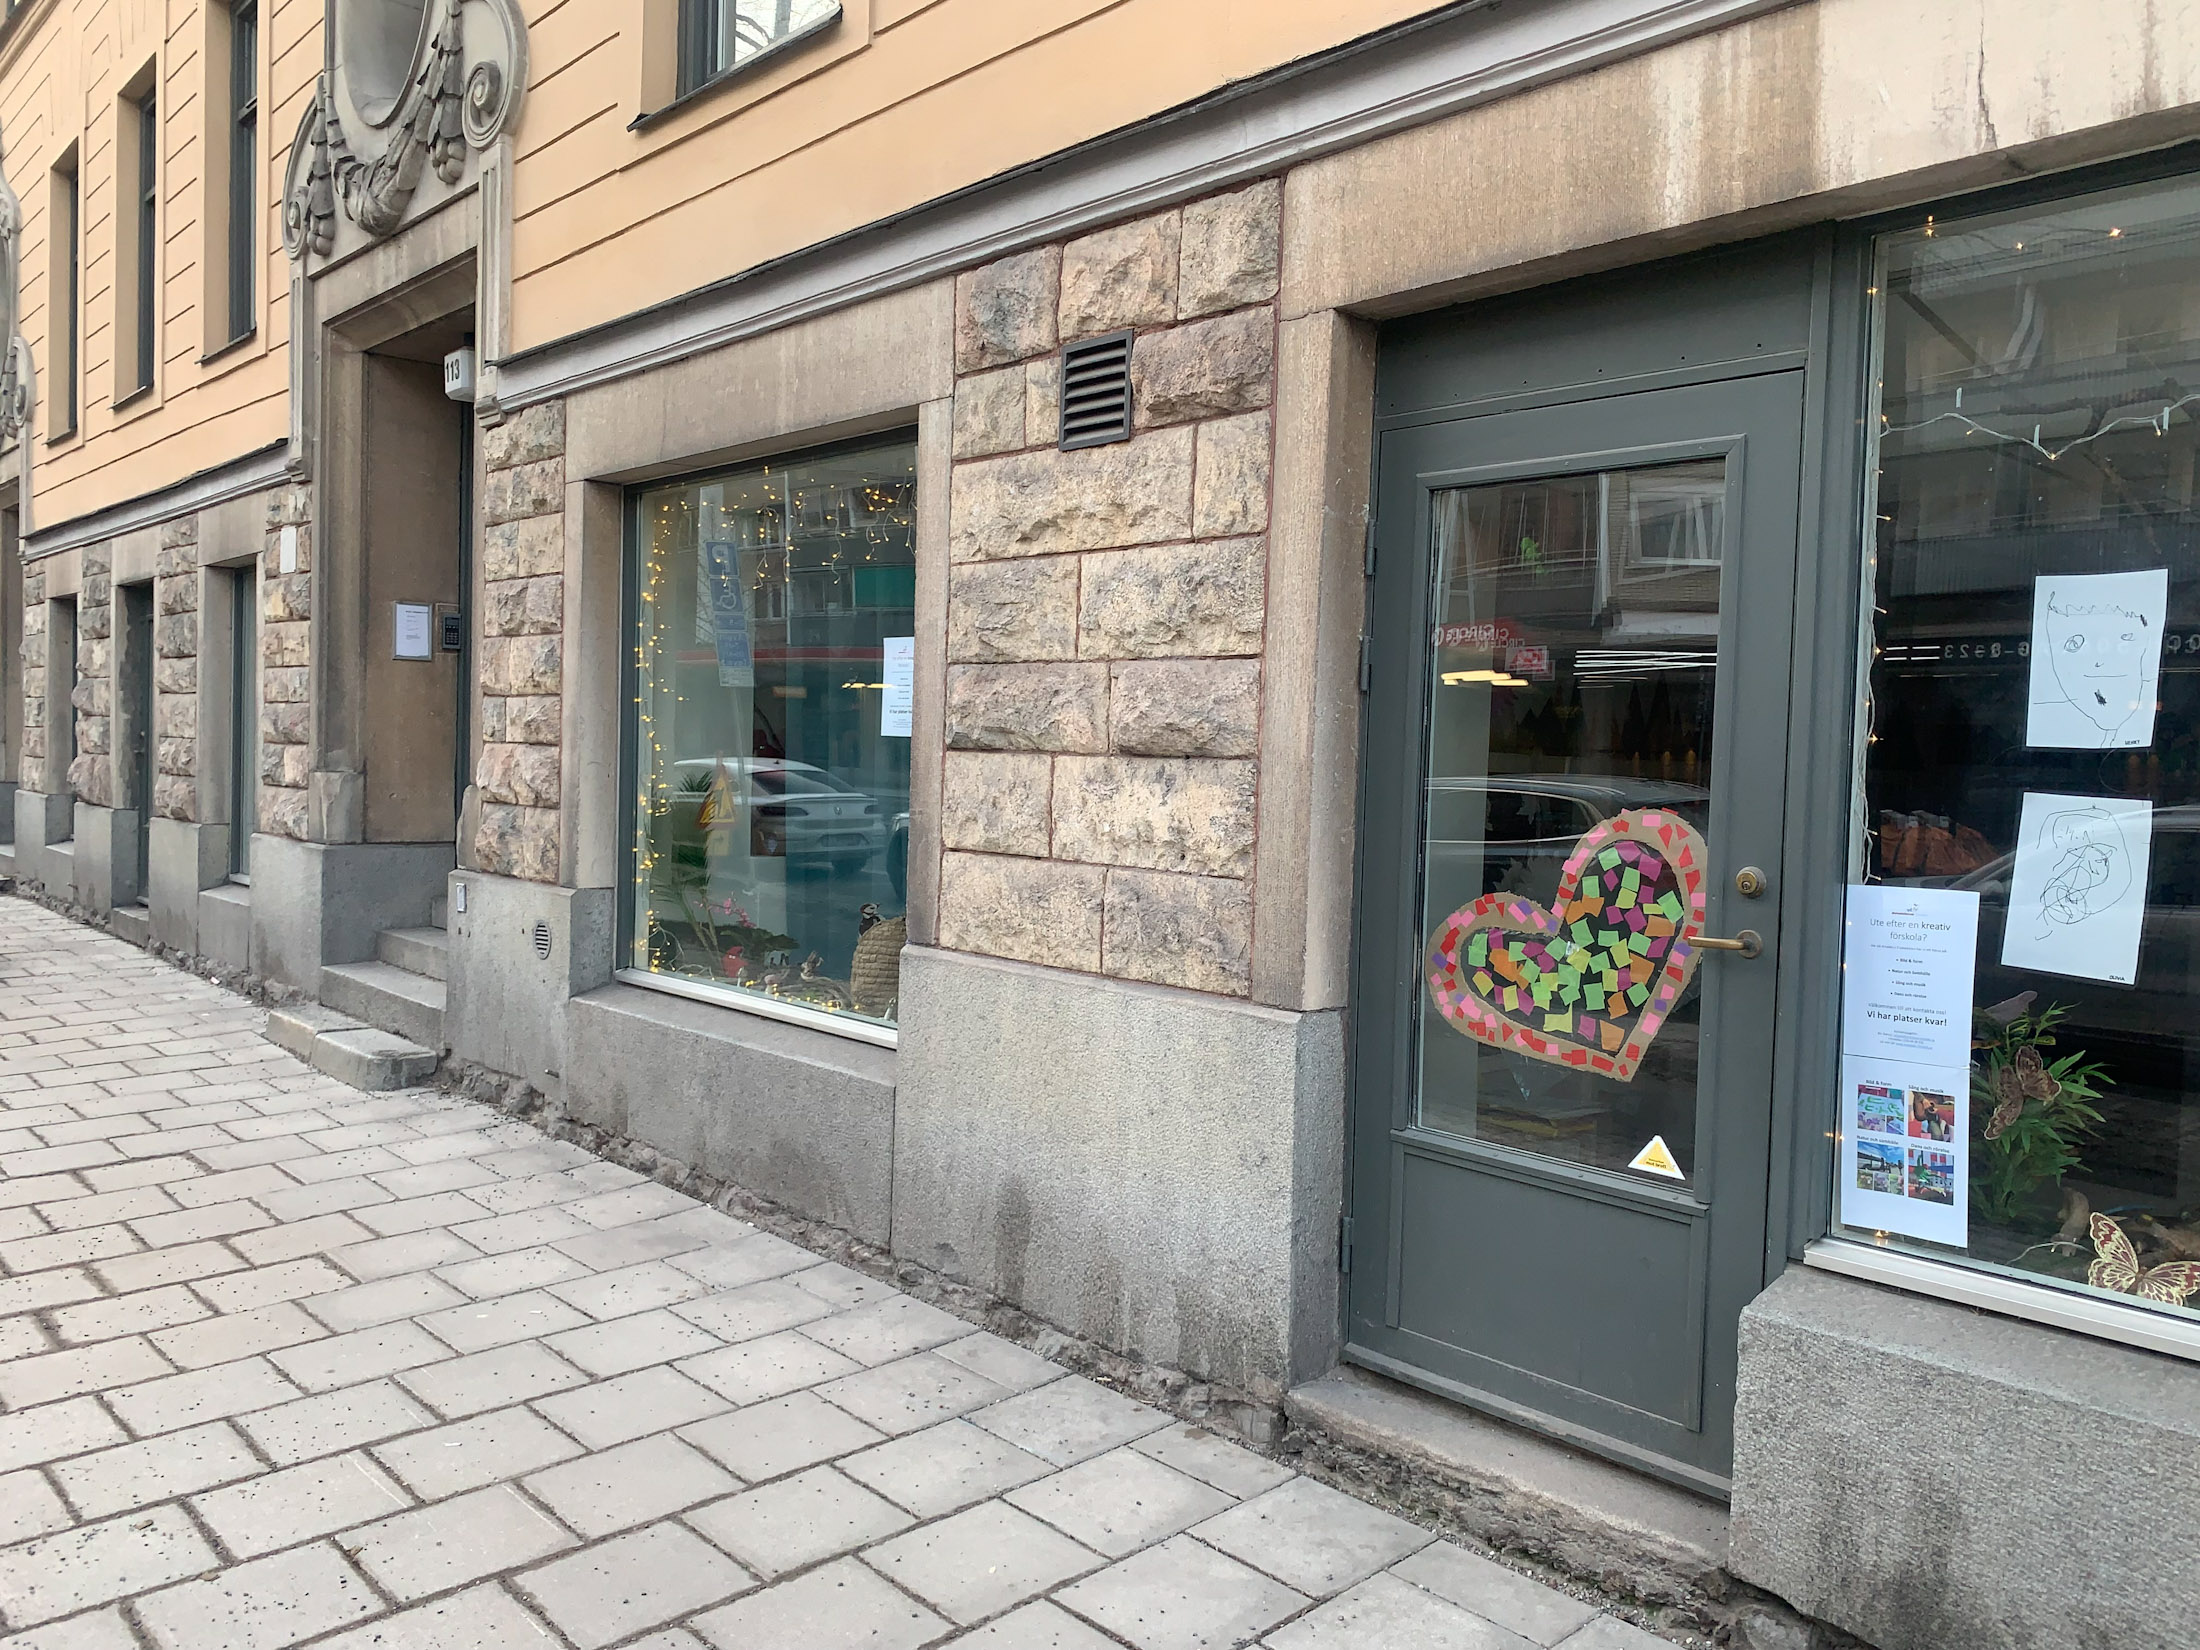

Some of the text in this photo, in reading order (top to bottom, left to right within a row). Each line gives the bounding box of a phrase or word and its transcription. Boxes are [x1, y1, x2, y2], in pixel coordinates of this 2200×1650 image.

[446, 358, 460, 383] 113
[1870, 918, 1884, 926] Ute
[1887, 920, 1906, 928] efter
[1921, 922, 1951, 931] kreativ
[1890, 932, 1927, 941] förskola?
[1894, 1014, 1922, 1023] platser
[1925, 1017, 1947, 1026] kvar!
